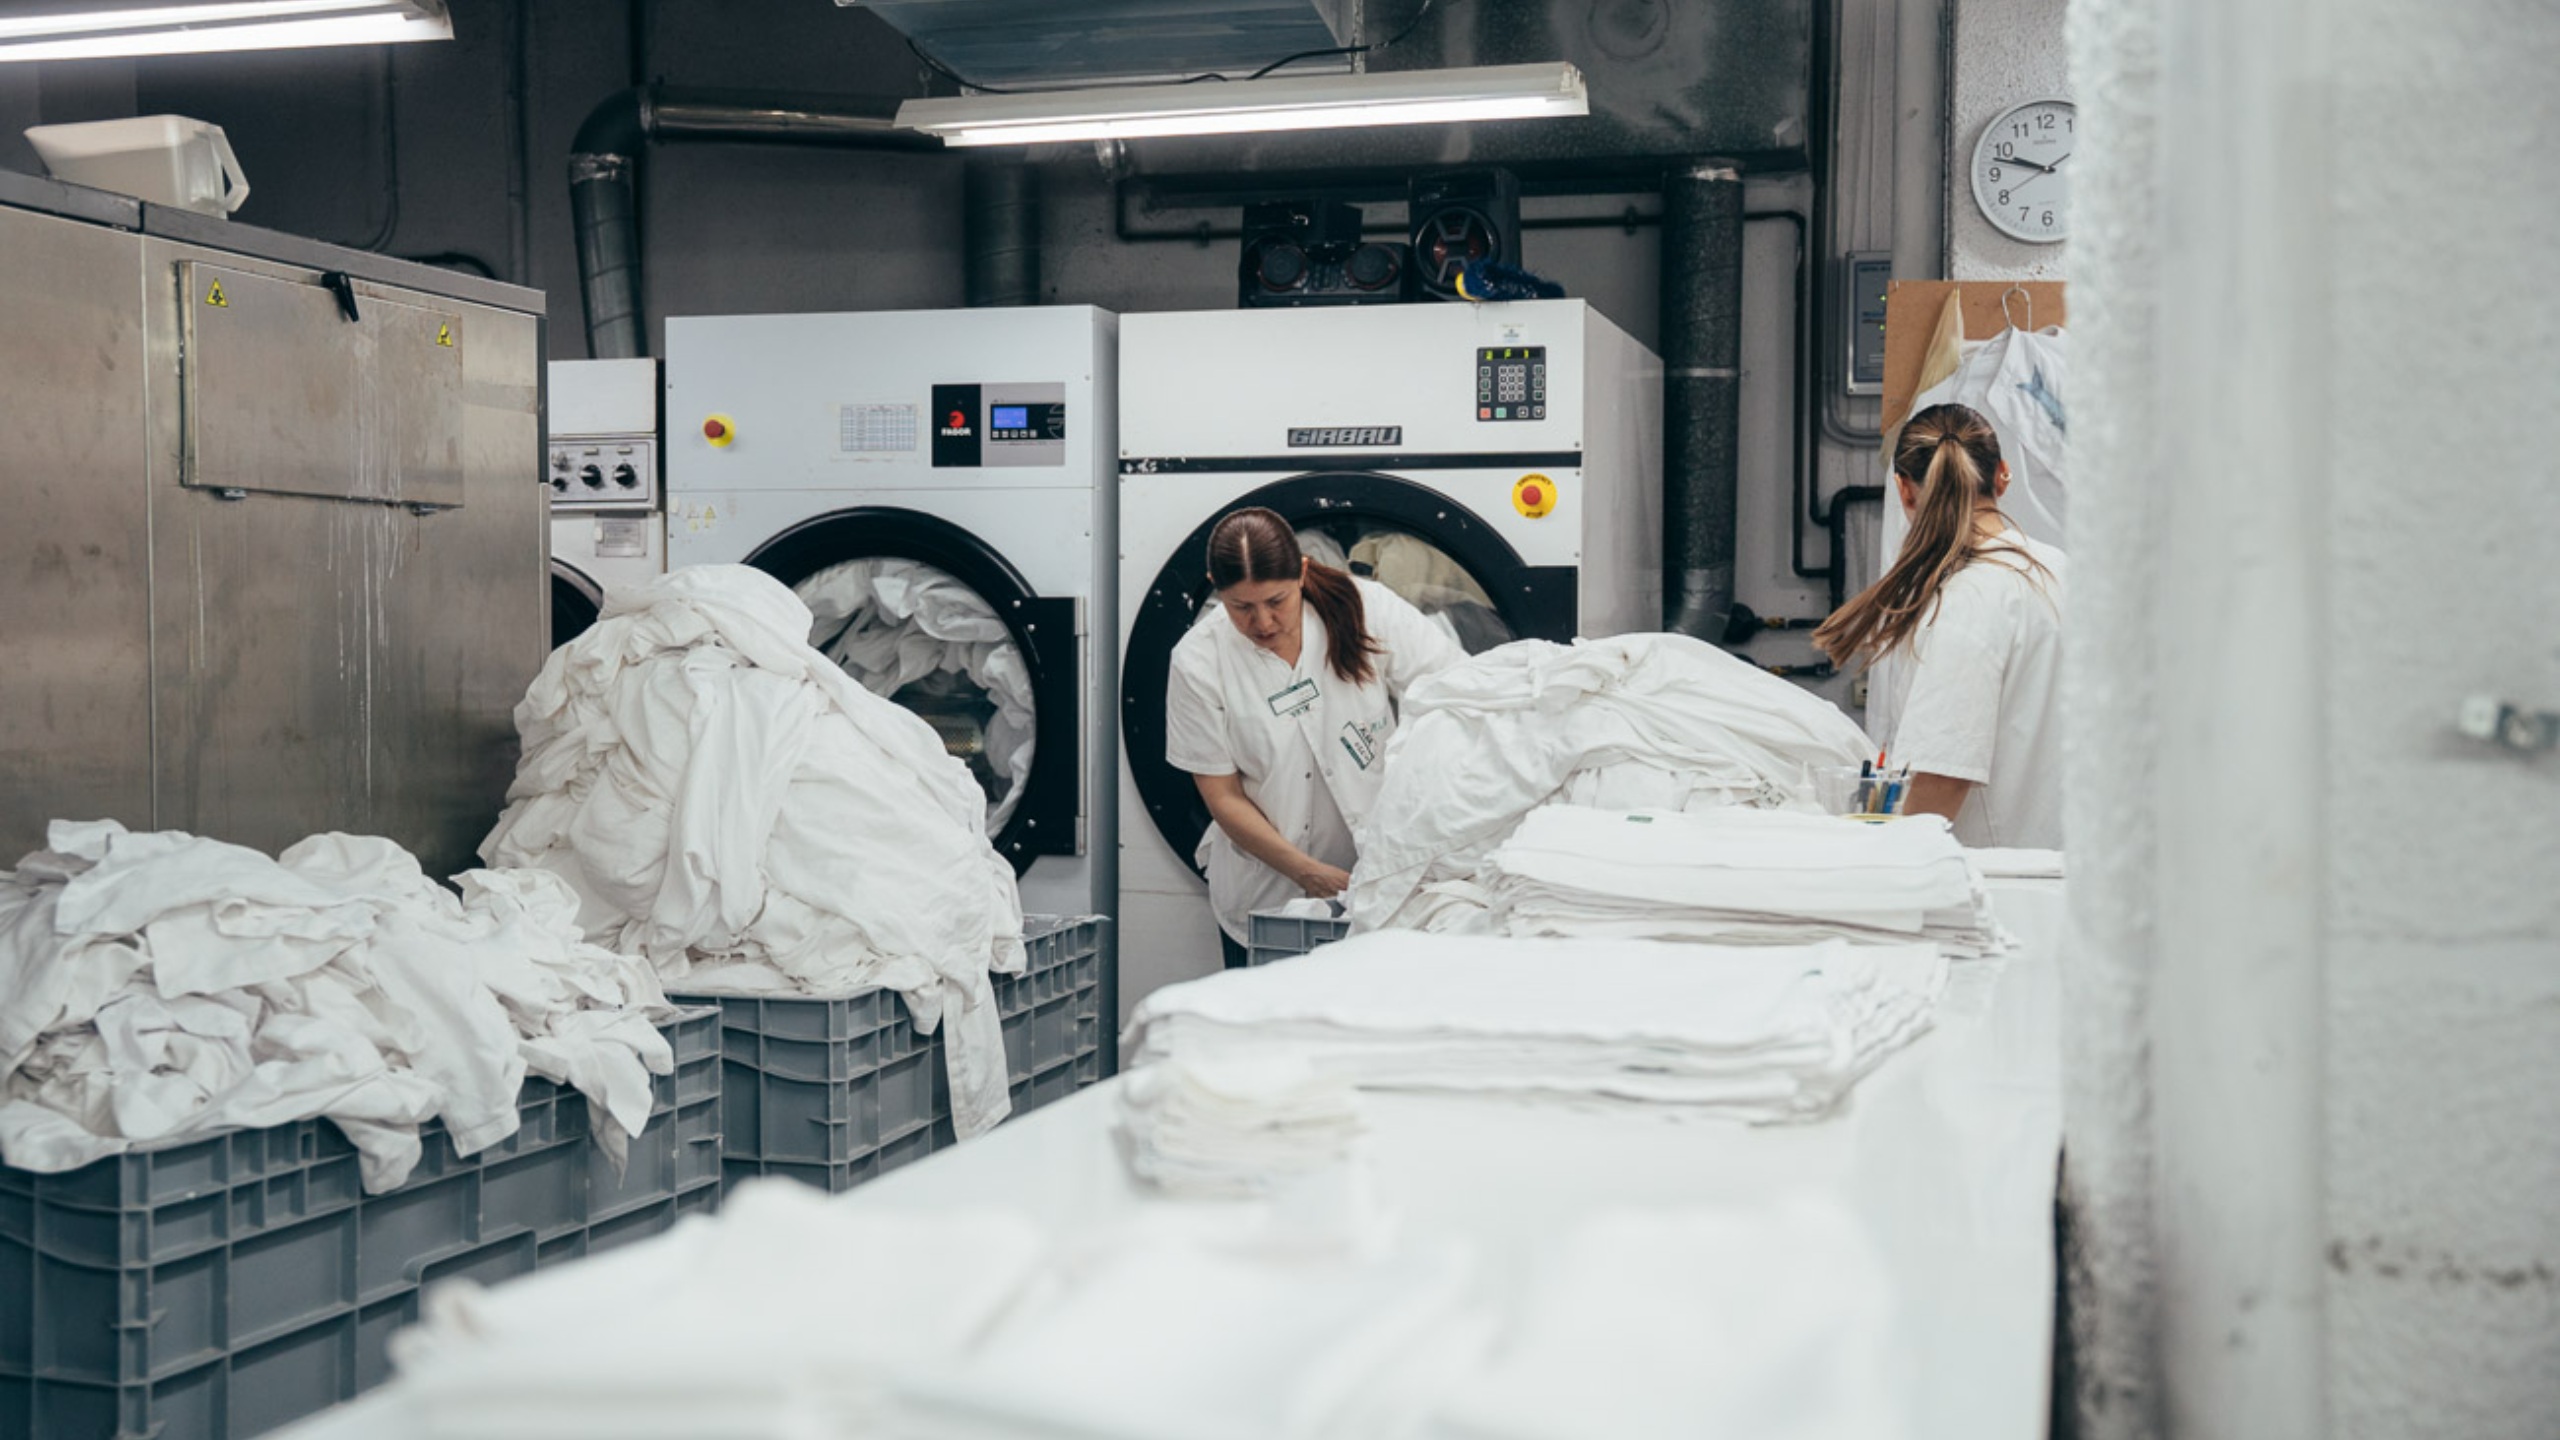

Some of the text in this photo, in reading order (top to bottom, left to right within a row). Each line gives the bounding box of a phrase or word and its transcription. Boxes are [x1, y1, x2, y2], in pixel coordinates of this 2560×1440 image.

[2036, 113, 2055, 129] 12
[2012, 122, 2029, 138] 11
[1994, 141, 2014, 158] 10
[1989, 167, 2001, 182] 9
[1998, 189, 2010, 205] 8
[2019, 206, 2030, 221] 7
[2041, 210, 2054, 226] 6
[941, 427, 972, 436] FAGOR
[1289, 427, 1399, 445] GIRBAU
